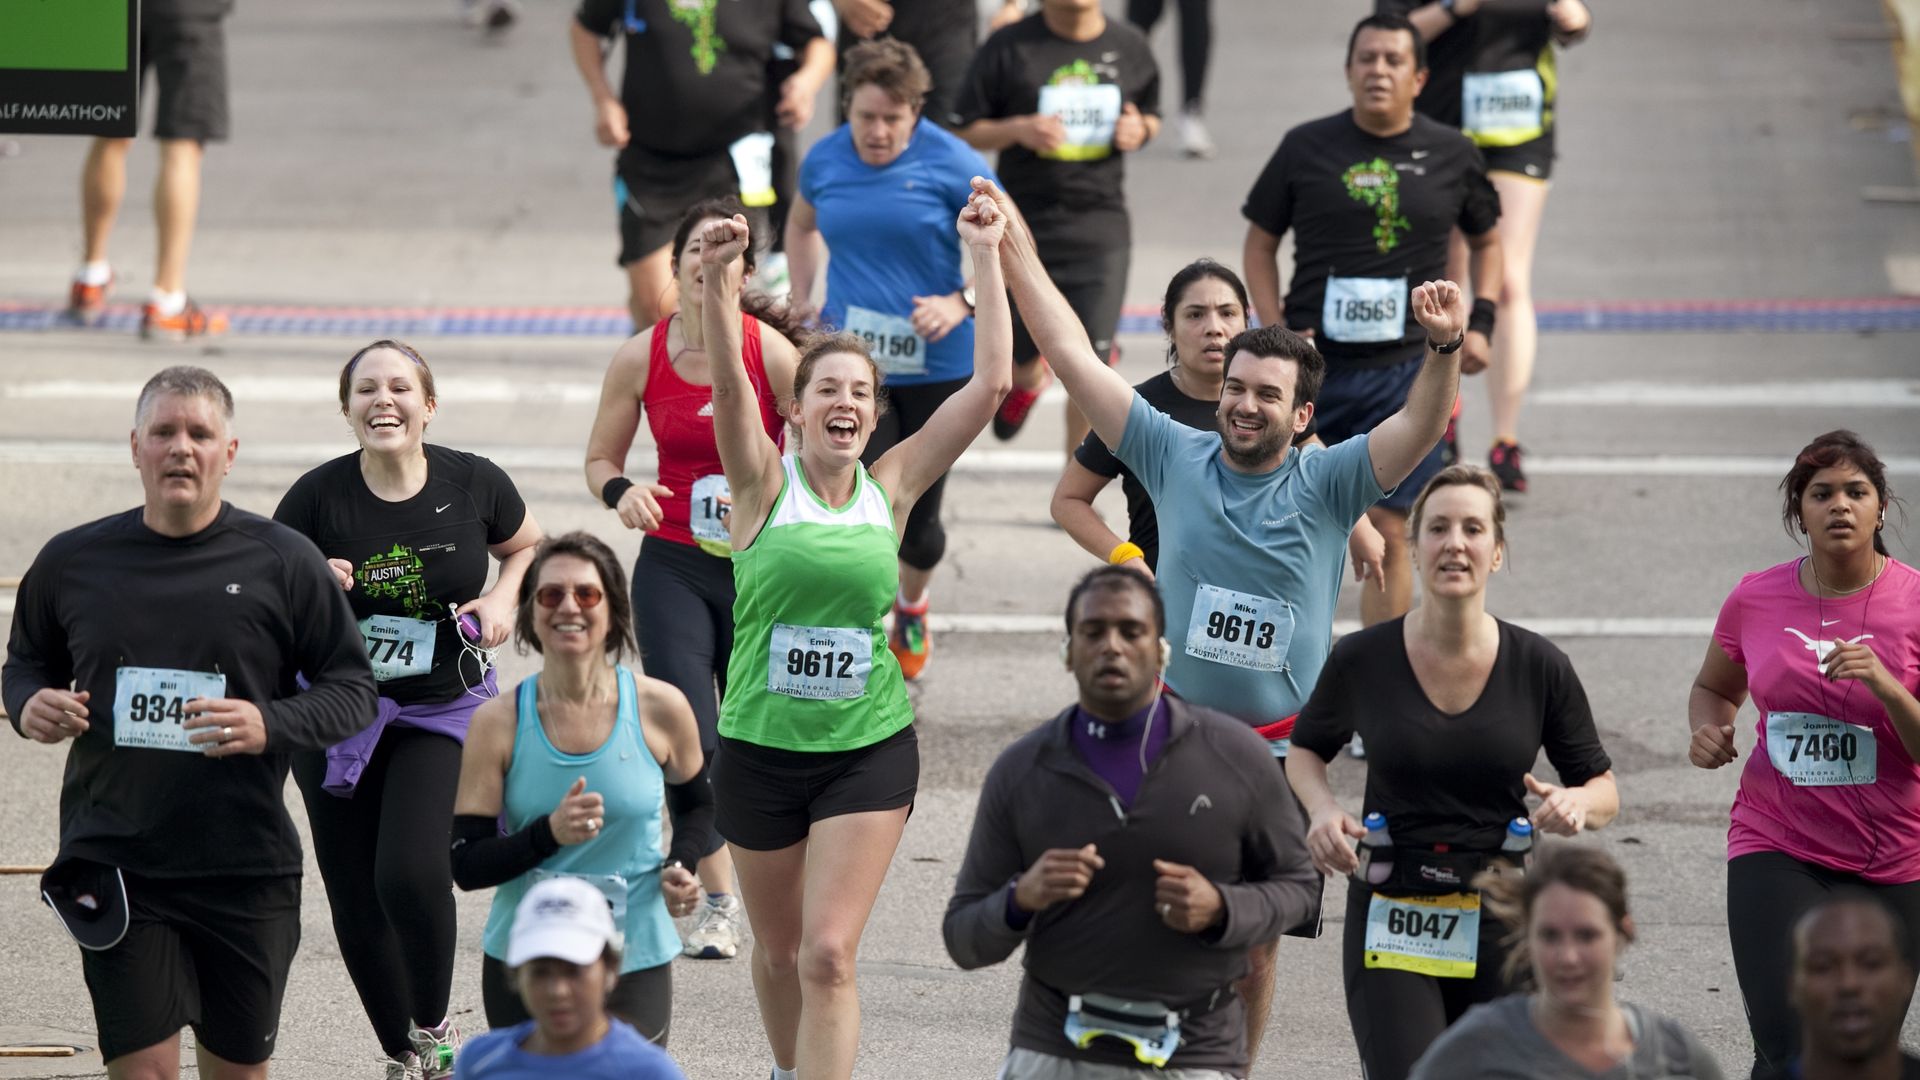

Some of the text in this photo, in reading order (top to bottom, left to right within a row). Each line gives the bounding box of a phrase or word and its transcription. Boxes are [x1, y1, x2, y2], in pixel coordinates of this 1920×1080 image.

[0, 103, 20, 119] LF
[1334, 297, 1398, 322] 18569
[370, 565, 405, 582] AUSTIN
[1234, 602, 1258, 615] Mike
[370, 625, 400, 636] Emilie
[1206, 611, 1276, 650] 9613
[809, 638, 836, 648] Emily
[1192, 648, 1219, 660] AUSTIN
[787, 647, 854, 679] 9612
[160, 681, 178, 691] Bill
[775, 686, 802, 696] AUSTIN
[1802, 722, 1841, 730] Joanne
[117, 735, 147, 745] AUSTIN
[1786, 732, 1857, 763] 7460
[1790, 775, 1807, 784] STIN
[1387, 907, 1460, 942] 6047
[1375, 941, 1405, 951] AUSTIN
